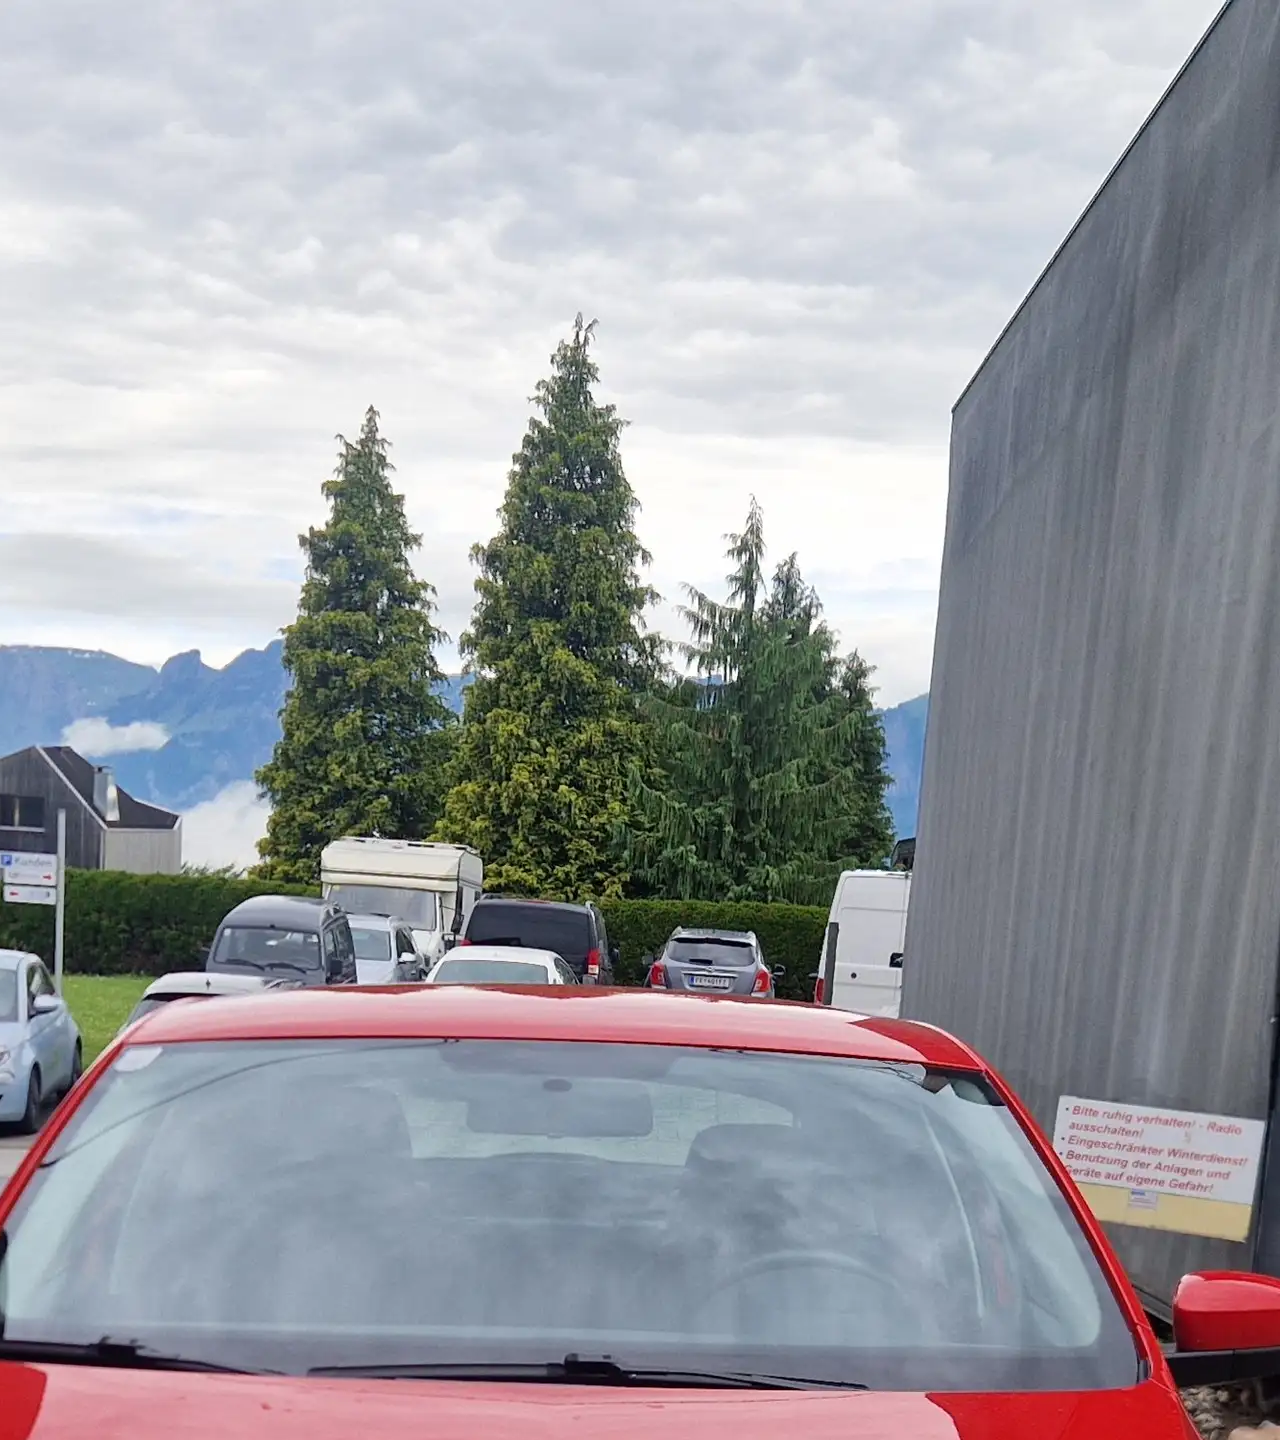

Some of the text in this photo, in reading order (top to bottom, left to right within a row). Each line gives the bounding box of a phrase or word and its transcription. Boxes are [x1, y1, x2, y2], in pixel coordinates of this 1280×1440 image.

[1068, 1121, 1144, 1138] ausschalten!
[1072, 1105, 1100, 1117] Bitte
[1102, 1110, 1134, 1124] ruhig
[1136, 1114, 1196, 1129] verhalten!
[1206, 1121, 1243, 1135] Radio
[1066, 1150, 1232, 1180] Benutzung der Anlagen und
[1067, 1135, 1248, 1167] Eingeschränkter Winterdienst!
[1104, 1171, 1125, 1181] auf
[1126, 1174, 1166, 1188] eigene
[1168, 1178, 1214, 1193] Gefahr!
